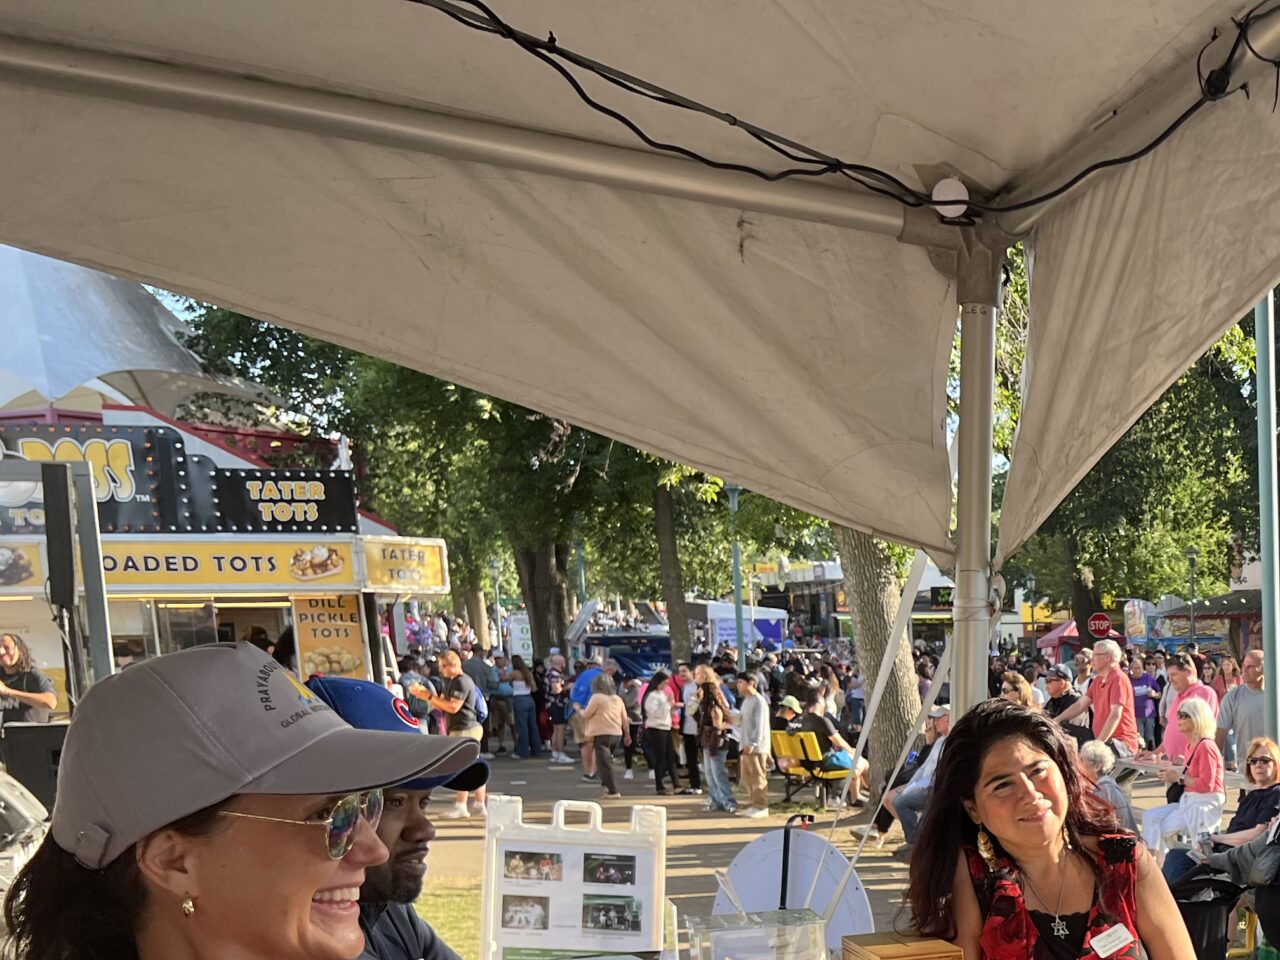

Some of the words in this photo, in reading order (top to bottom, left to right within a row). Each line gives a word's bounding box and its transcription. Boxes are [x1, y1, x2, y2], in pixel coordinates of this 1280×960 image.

[247, 480, 325, 500] TATER
[258, 502, 318, 522] TOTS
[382, 548, 426, 562] TATER
[213, 556, 276, 572] TOTS
[309, 598, 345, 608] DILL
[300, 612, 358, 623] PICKLE
[1090, 620, 1109, 630] STOP
[312, 628, 349, 638] TOTS
[281, 709, 311, 728] GLOBAL
[392, 697, 420, 729] C
